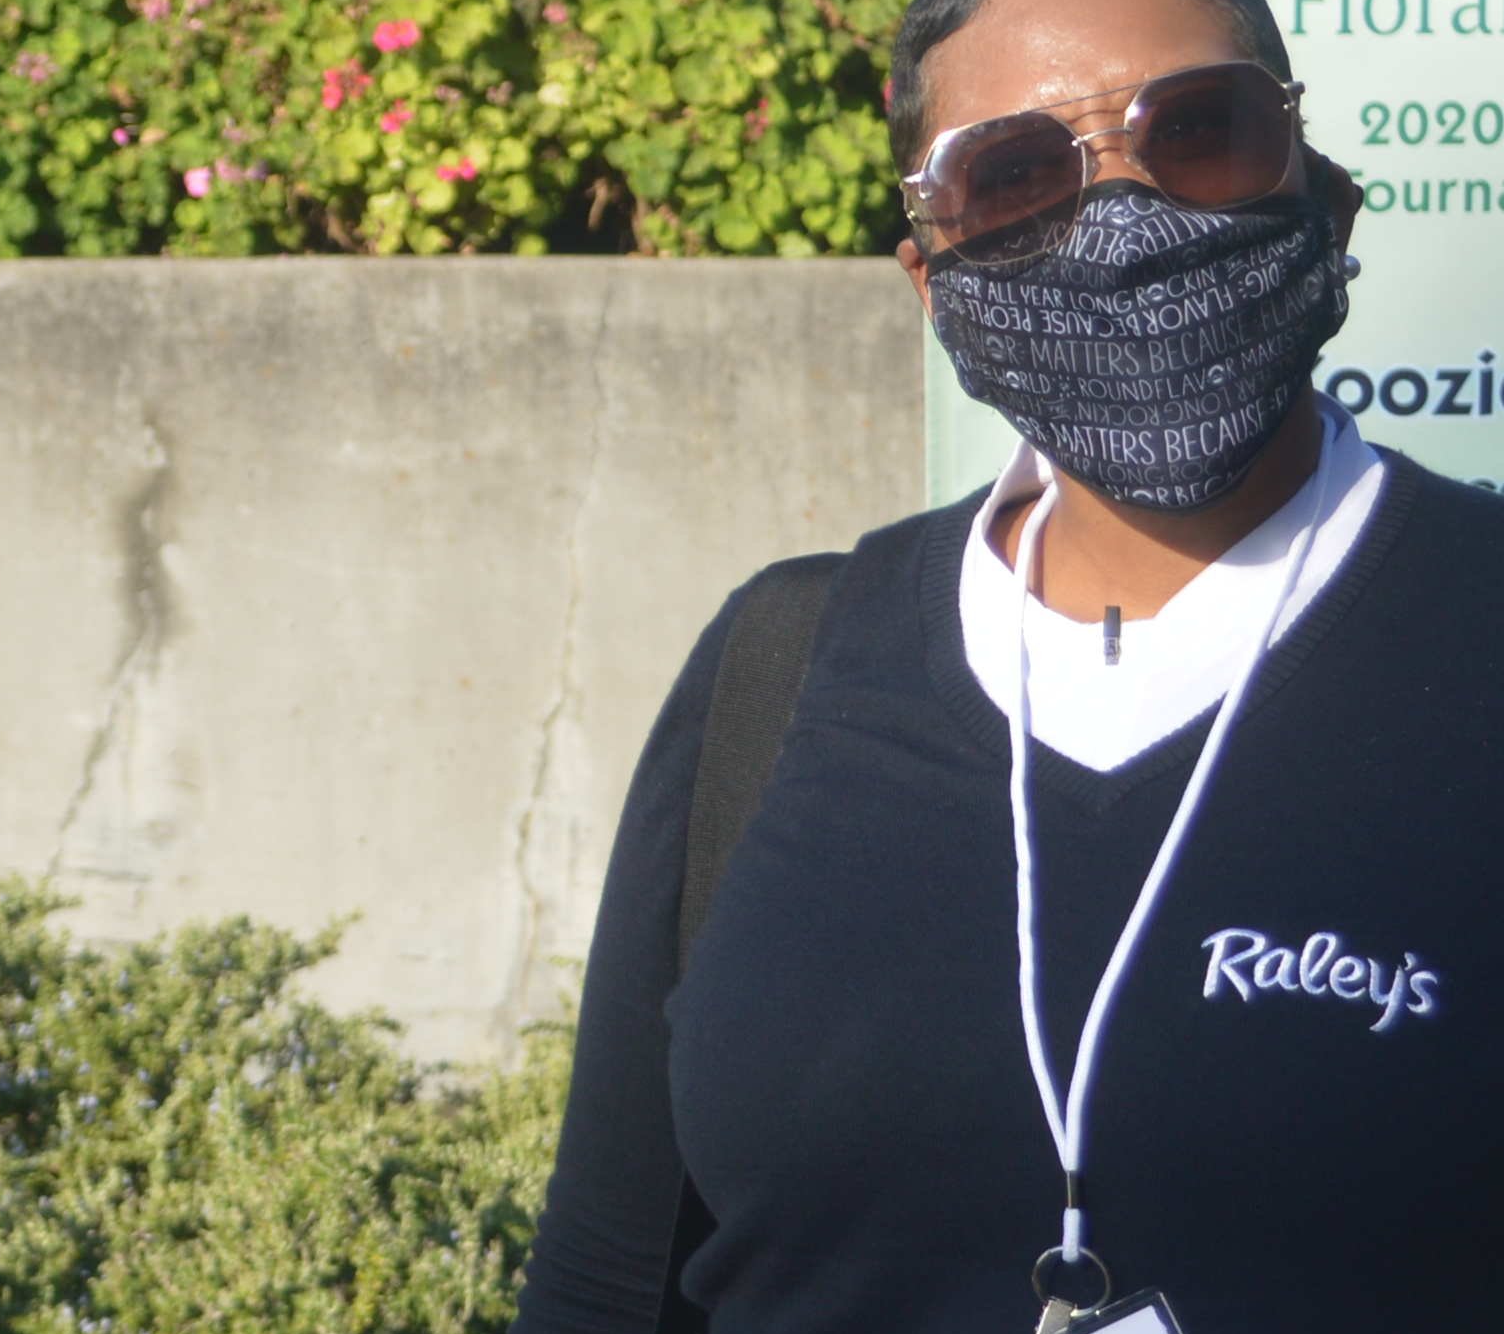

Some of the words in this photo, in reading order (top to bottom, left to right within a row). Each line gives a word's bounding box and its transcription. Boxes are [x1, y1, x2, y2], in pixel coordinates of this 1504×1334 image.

[1359, 100, 1504, 146] 2020
[967, 299, 1032, 332] PEOPLE
[988, 281, 1018, 305] ALL
[1019, 285, 1064, 314] YEAR
[1069, 291, 1133, 315] LONG
[1142, 285, 1234, 336] FLAVOR
[1030, 338, 1140, 376] MATTERS
[1147, 311, 1250, 375] BECAUSE
[1042, 310, 1141, 338] BECAUSE
[1164, 387, 1232, 424] LONG
[1050, 421, 1155, 465] MATTERS
[1164, 396, 1266, 464] BECAUSE
[1097, 461, 1164, 485] LONG
[1201, 927, 1440, 1033] Raley's
